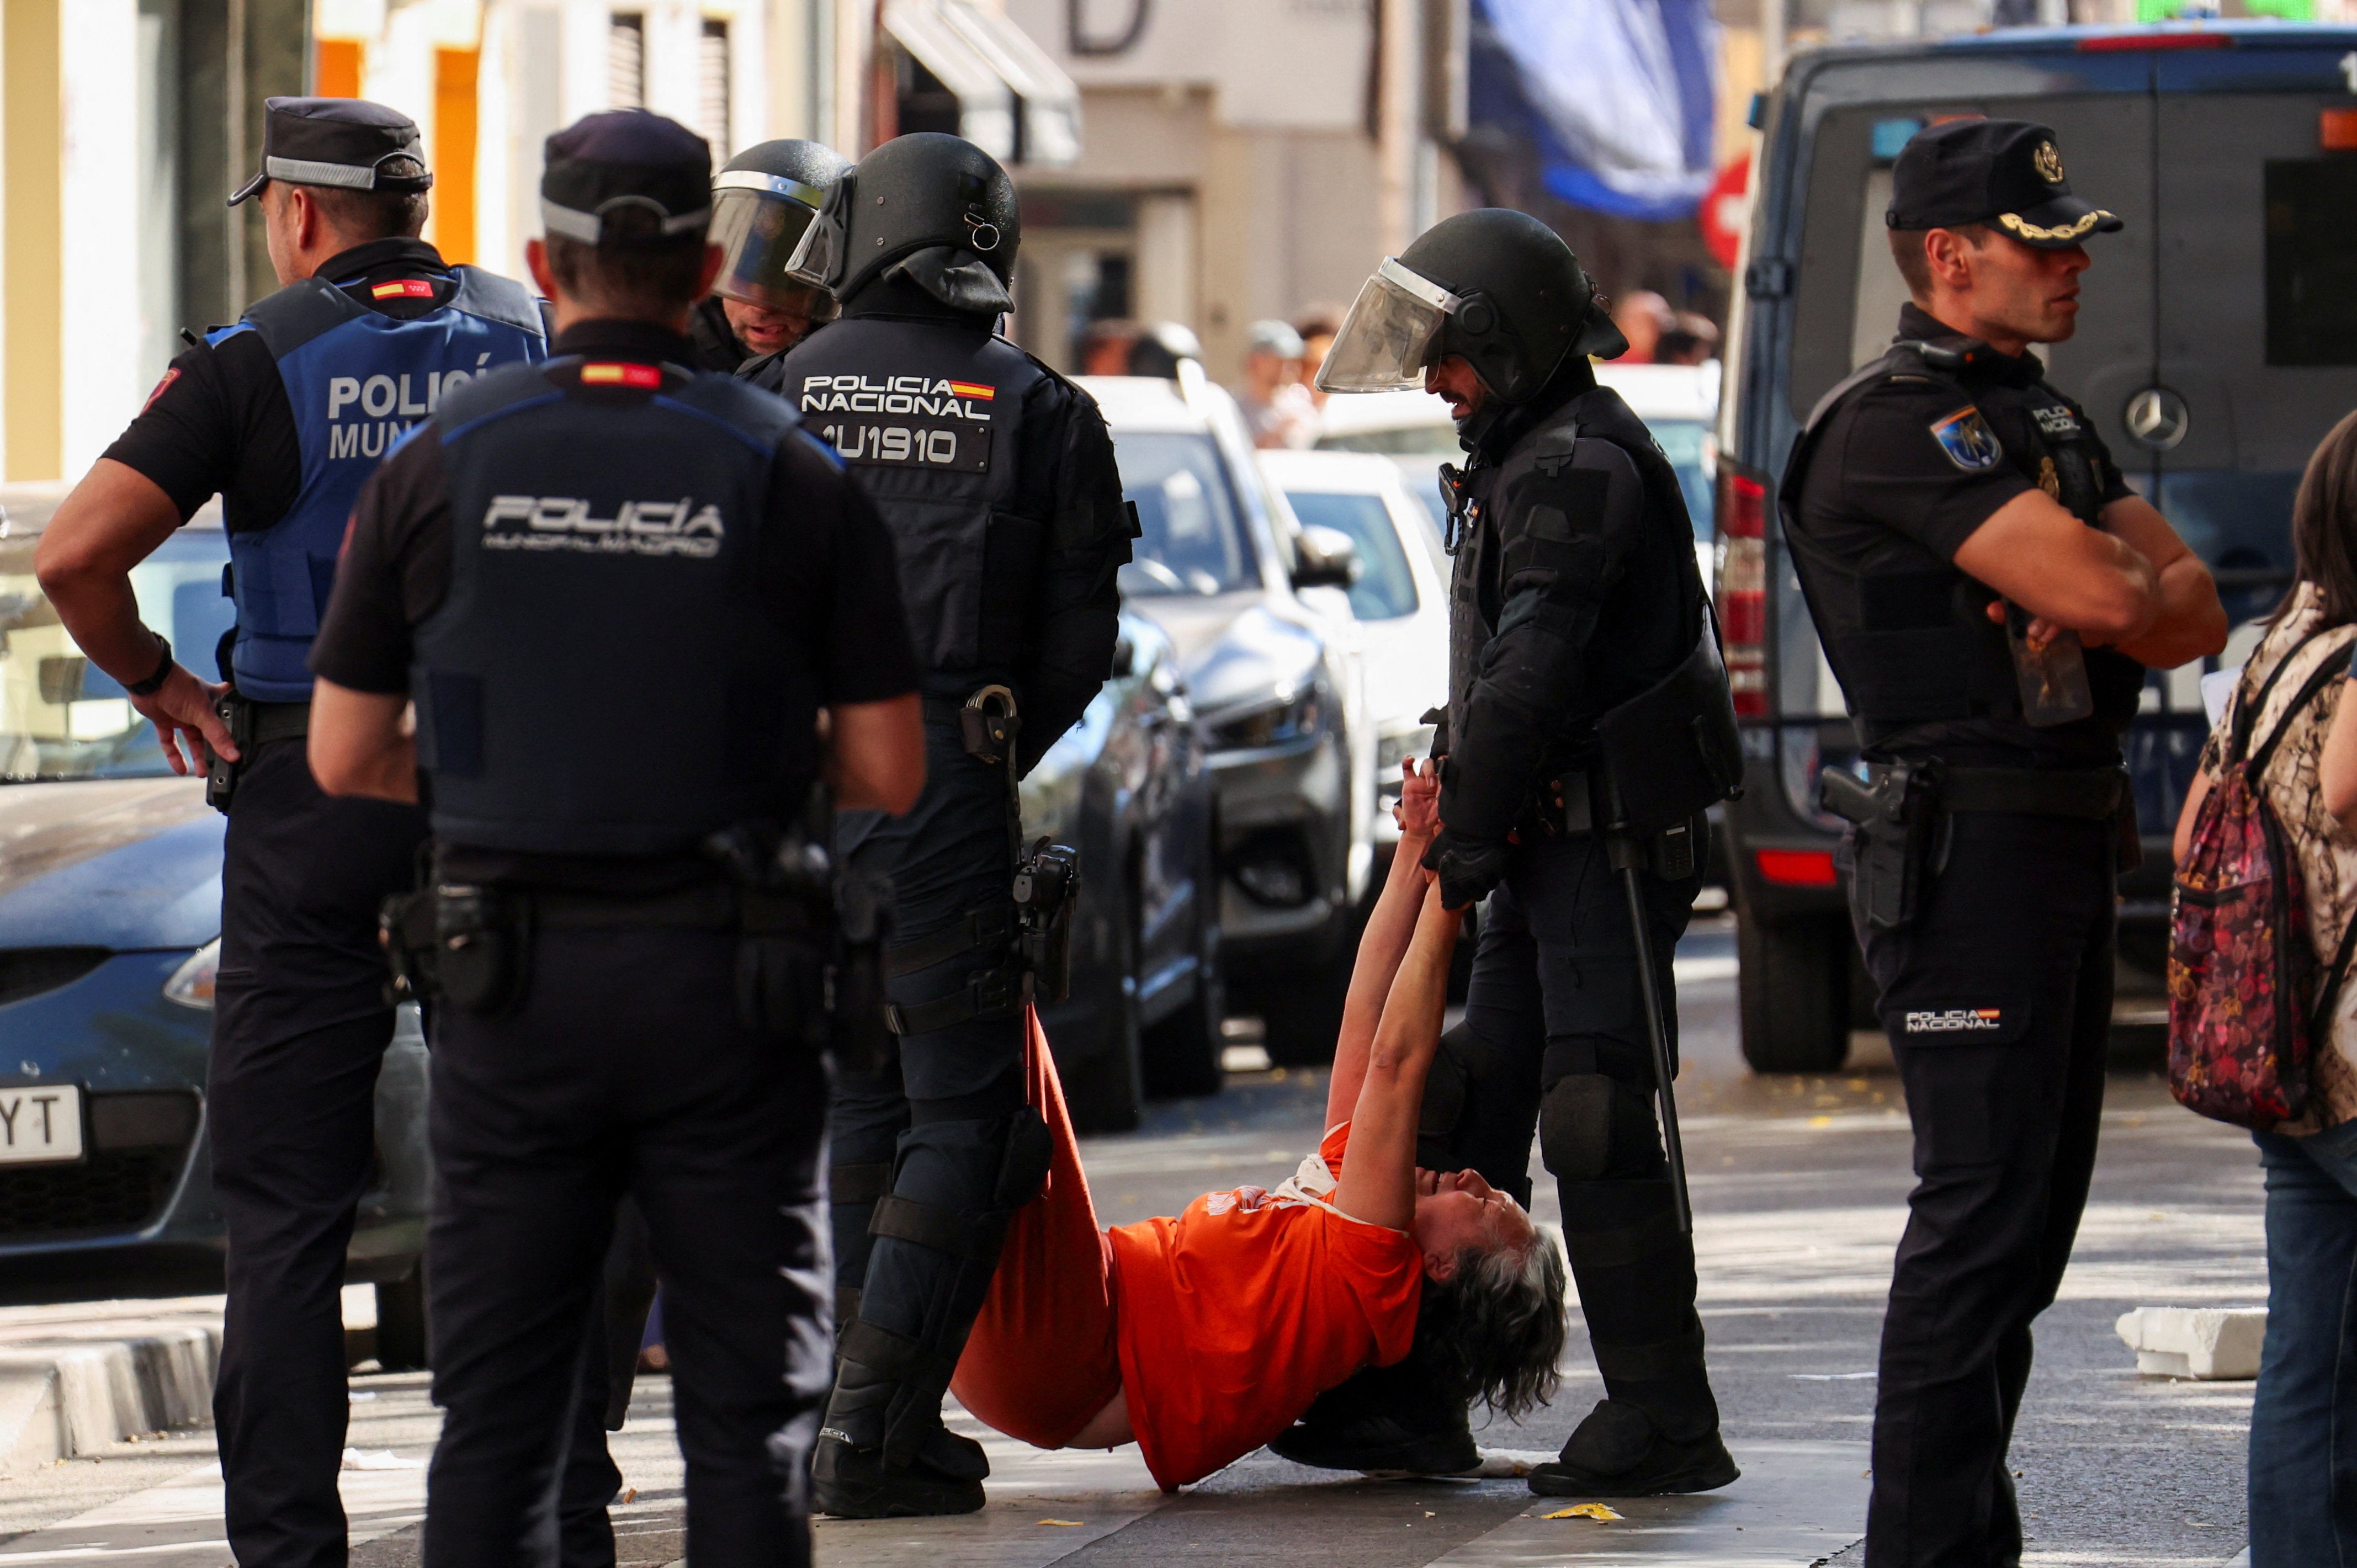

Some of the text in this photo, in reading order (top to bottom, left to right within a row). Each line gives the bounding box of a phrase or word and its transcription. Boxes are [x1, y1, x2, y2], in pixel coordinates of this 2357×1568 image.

[801, 392, 991, 421] NACIONAL
[1907, 1009, 1980, 1022] POLICIA
[1905, 1018, 2000, 1033] NACIONAL
